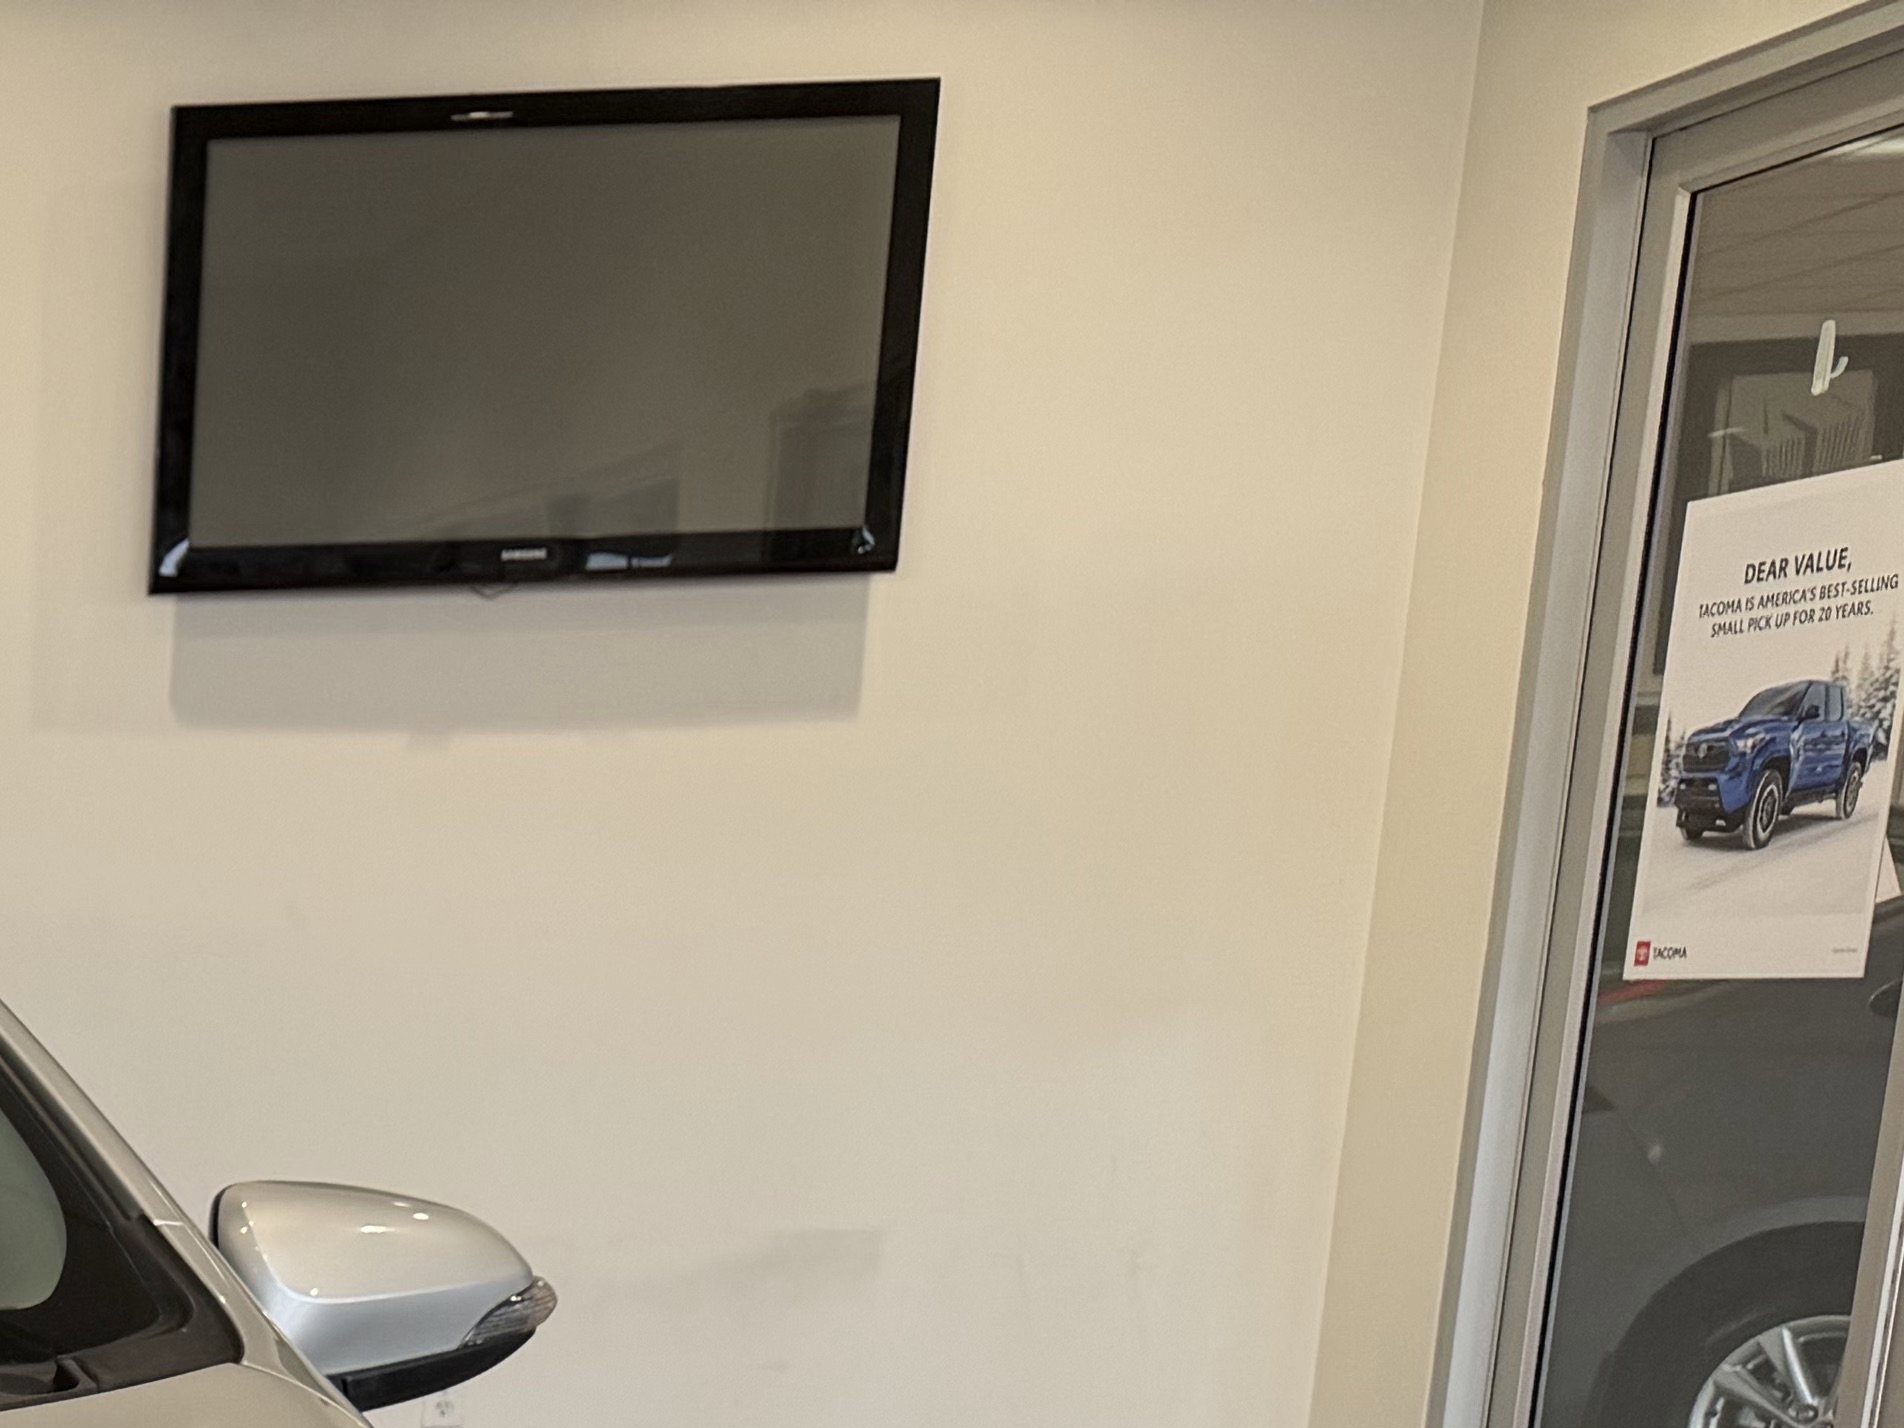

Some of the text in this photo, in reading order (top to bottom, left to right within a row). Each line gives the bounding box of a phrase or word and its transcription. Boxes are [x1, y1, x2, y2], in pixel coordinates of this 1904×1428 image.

[1744, 547, 1852, 584] DEAR VALUE,
[1699, 573, 1899, 619] TACOMA IS AMERICA'S BEST-SELLING
[1710, 600, 1874, 638] SMALL PICK UP FOR 20 YEARS.
